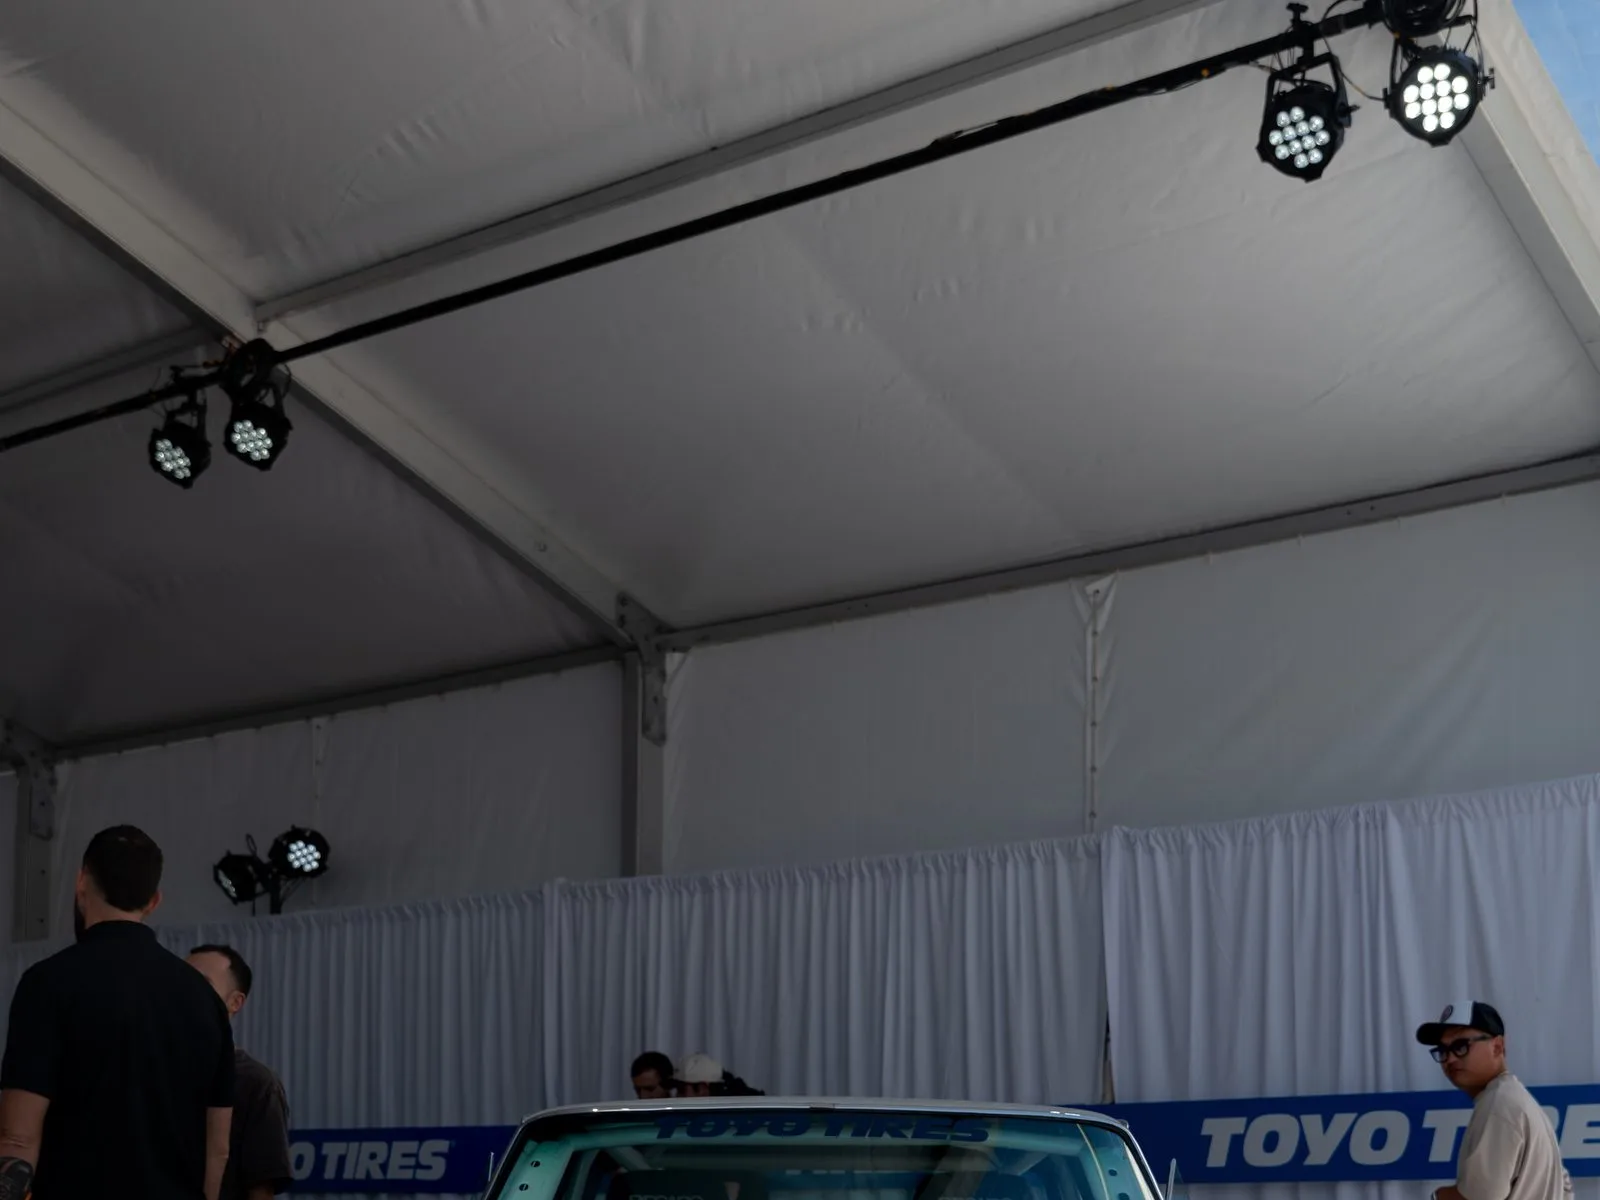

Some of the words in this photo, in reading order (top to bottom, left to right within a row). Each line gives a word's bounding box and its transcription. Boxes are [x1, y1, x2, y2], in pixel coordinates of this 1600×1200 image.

[654, 1114, 813, 1139] TOYO
[823, 1115, 990, 1142] TIRES
[1200, 1109, 1411, 1168] TOYO
[321, 1139, 450, 1181] TIRES
